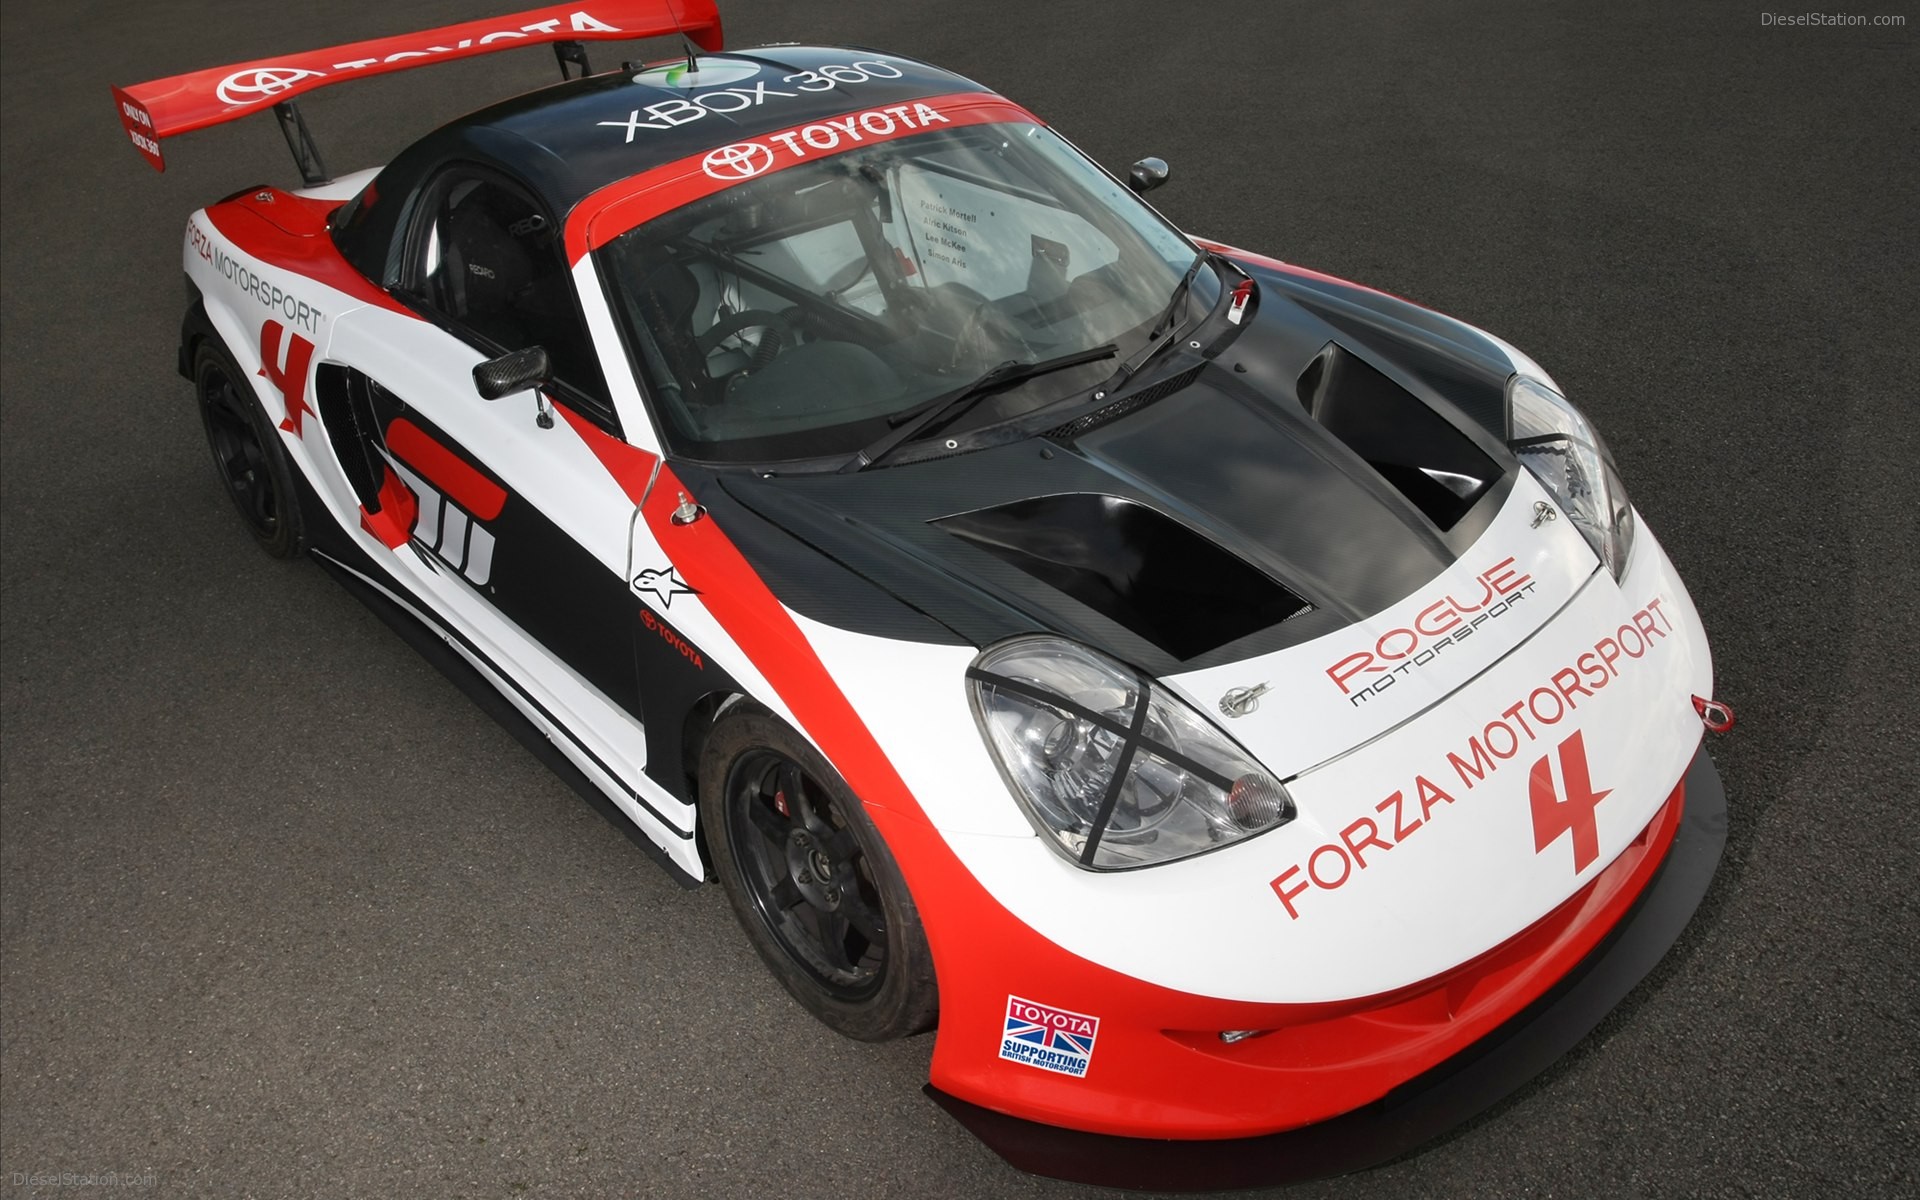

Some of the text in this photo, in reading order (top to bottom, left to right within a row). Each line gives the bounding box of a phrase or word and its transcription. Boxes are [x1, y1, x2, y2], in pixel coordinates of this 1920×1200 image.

[122, 101, 152, 129] ONLY ON
[597, 60, 903, 143] XBOX 360
[129, 129, 160, 157] XBOX 360
[770, 103, 950, 157] TOYOTA
[920, 200, 977, 223] Patrick Mortell
[923, 216, 967, 237] Alric Kitson
[925, 232, 966, 253] Lee McKee
[927, 248, 967, 268] Simon Aris
[187, 219, 321, 334] FORZA MOTORSPORT
[257, 318, 317, 441] 4
[657, 621, 704, 671] TOYOTA
[1325, 556, 1532, 696] ROGUE
[1350, 581, 1536, 708] MOTORSPORT
[1269, 602, 1675, 921] FORZA MOTORSPORT
[1528, 728, 1615, 876] 4
[1012, 1001, 1093, 1035] TOYOTA
[1001, 1050, 1085, 1075] BRITISH MOTORSPORT
[1003, 1039, 1087, 1069] SUPPORTING
